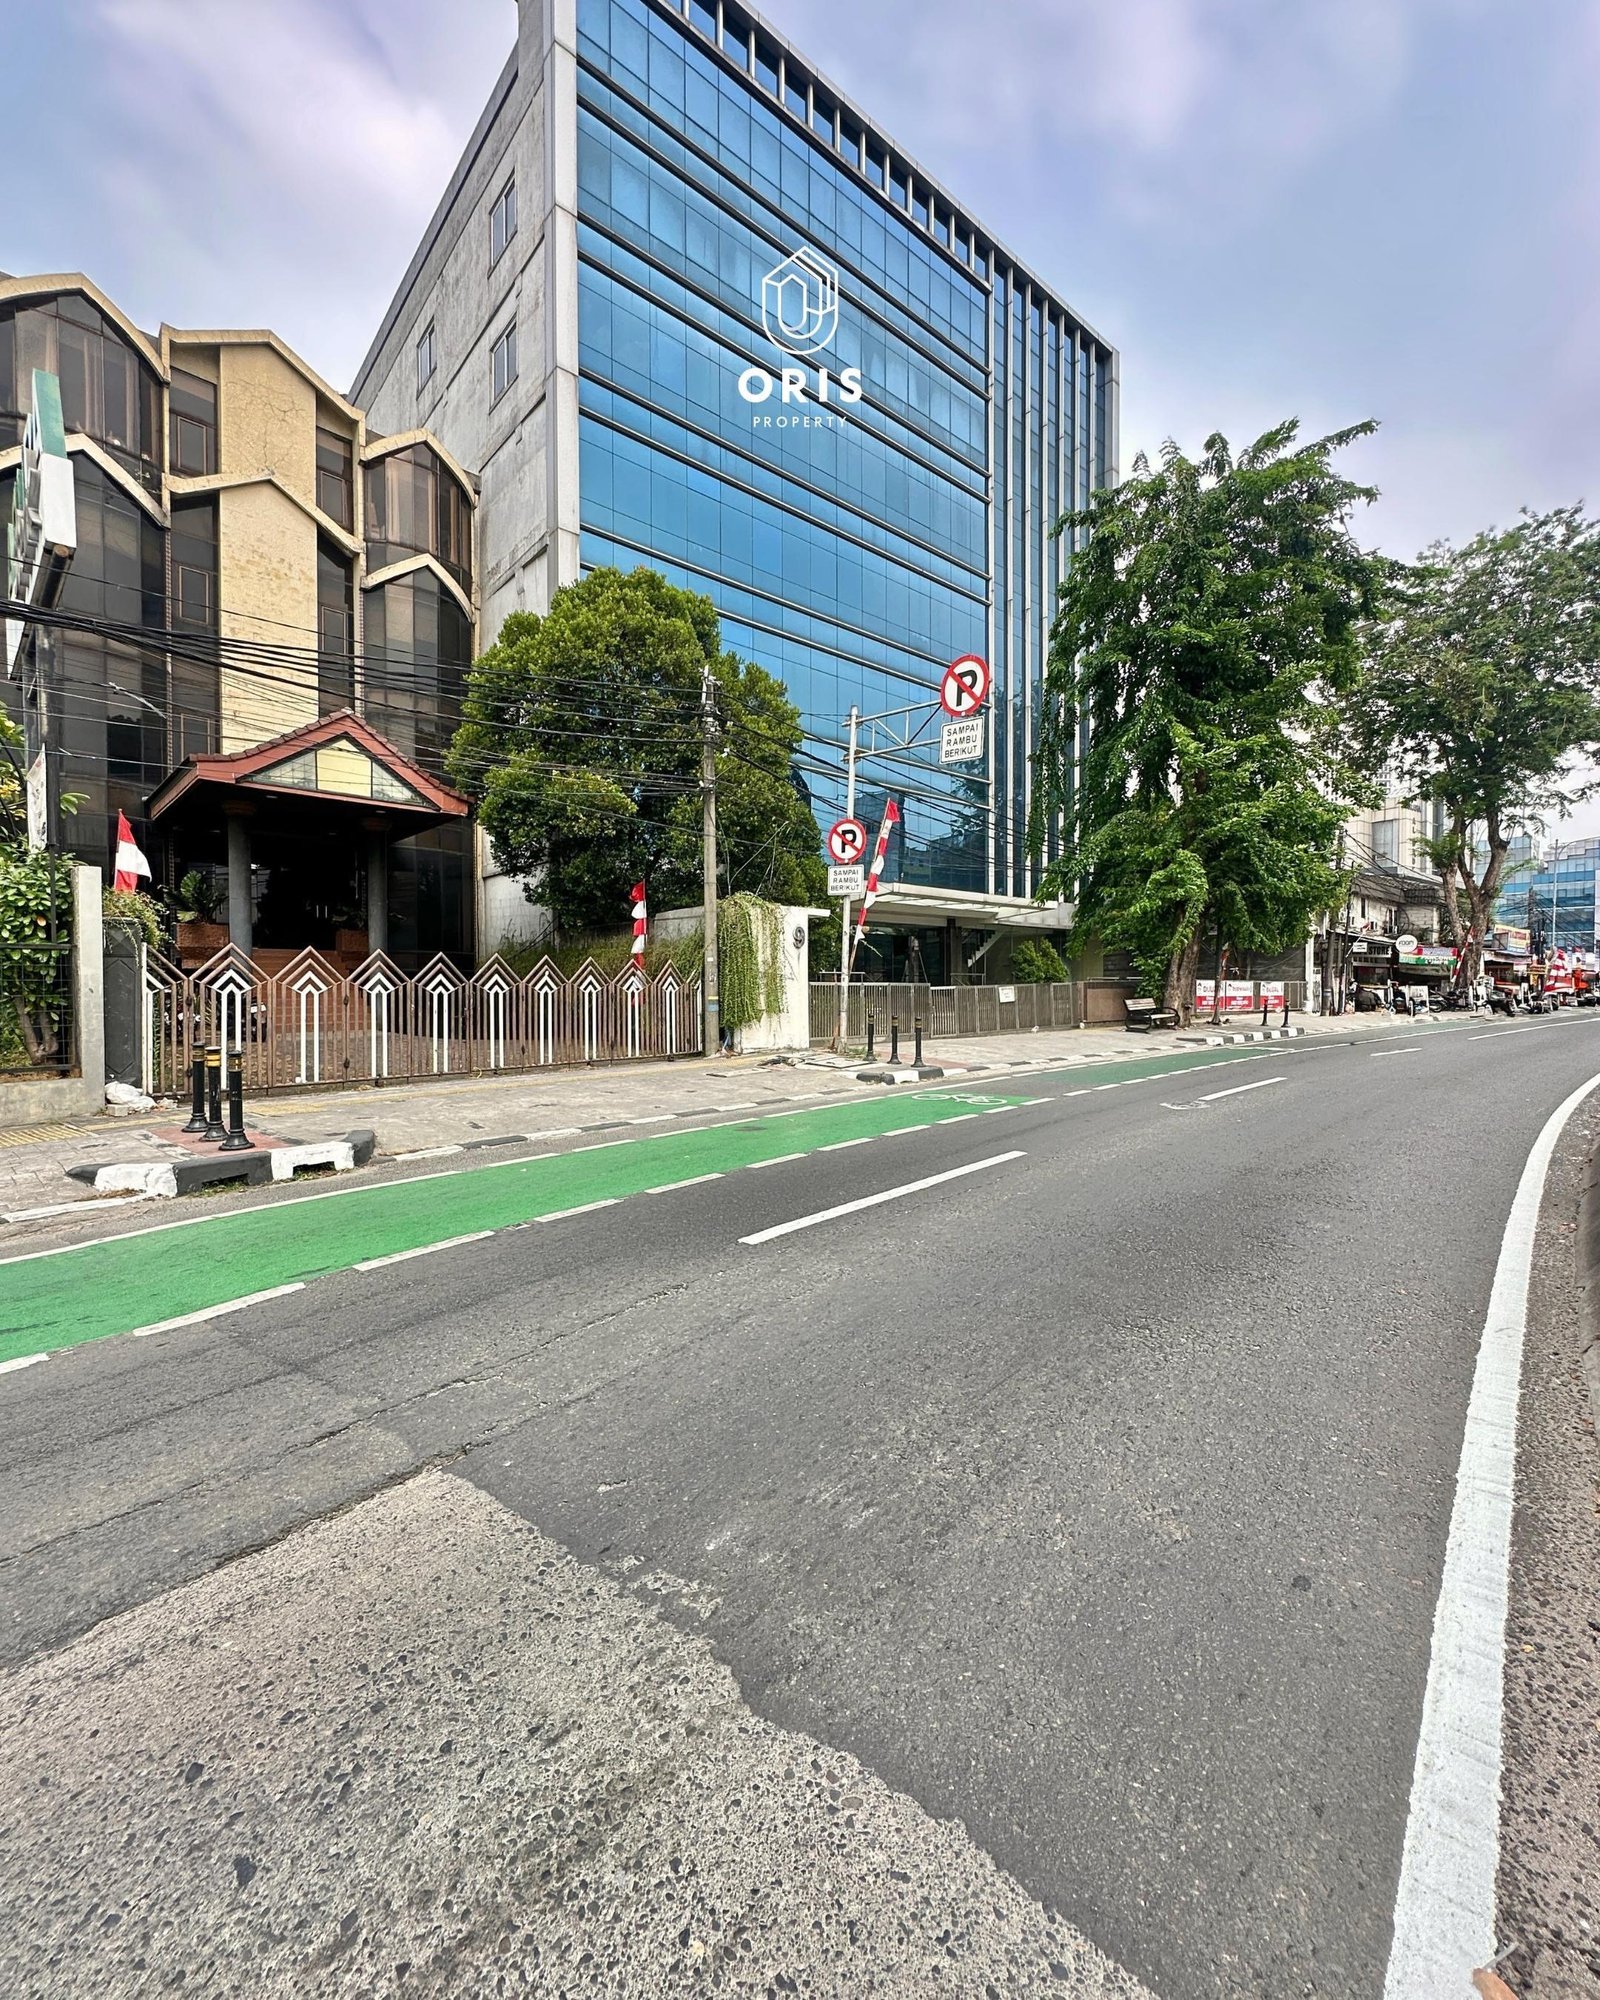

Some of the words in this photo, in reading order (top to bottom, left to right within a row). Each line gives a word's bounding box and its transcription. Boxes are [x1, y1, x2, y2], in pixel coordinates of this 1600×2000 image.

[947, 723, 979, 737] SAMPAI
[946, 734, 978, 748] RAMBU
[945, 744, 978, 759] BERIKUT
[833, 869, 859, 877] SAMPAI
[833, 876, 858, 884] RAMBU
[831, 884, 860, 892] BERIKUT
[792, 926, 806, 950] 9
[1368, 945, 1390, 956] STORE
